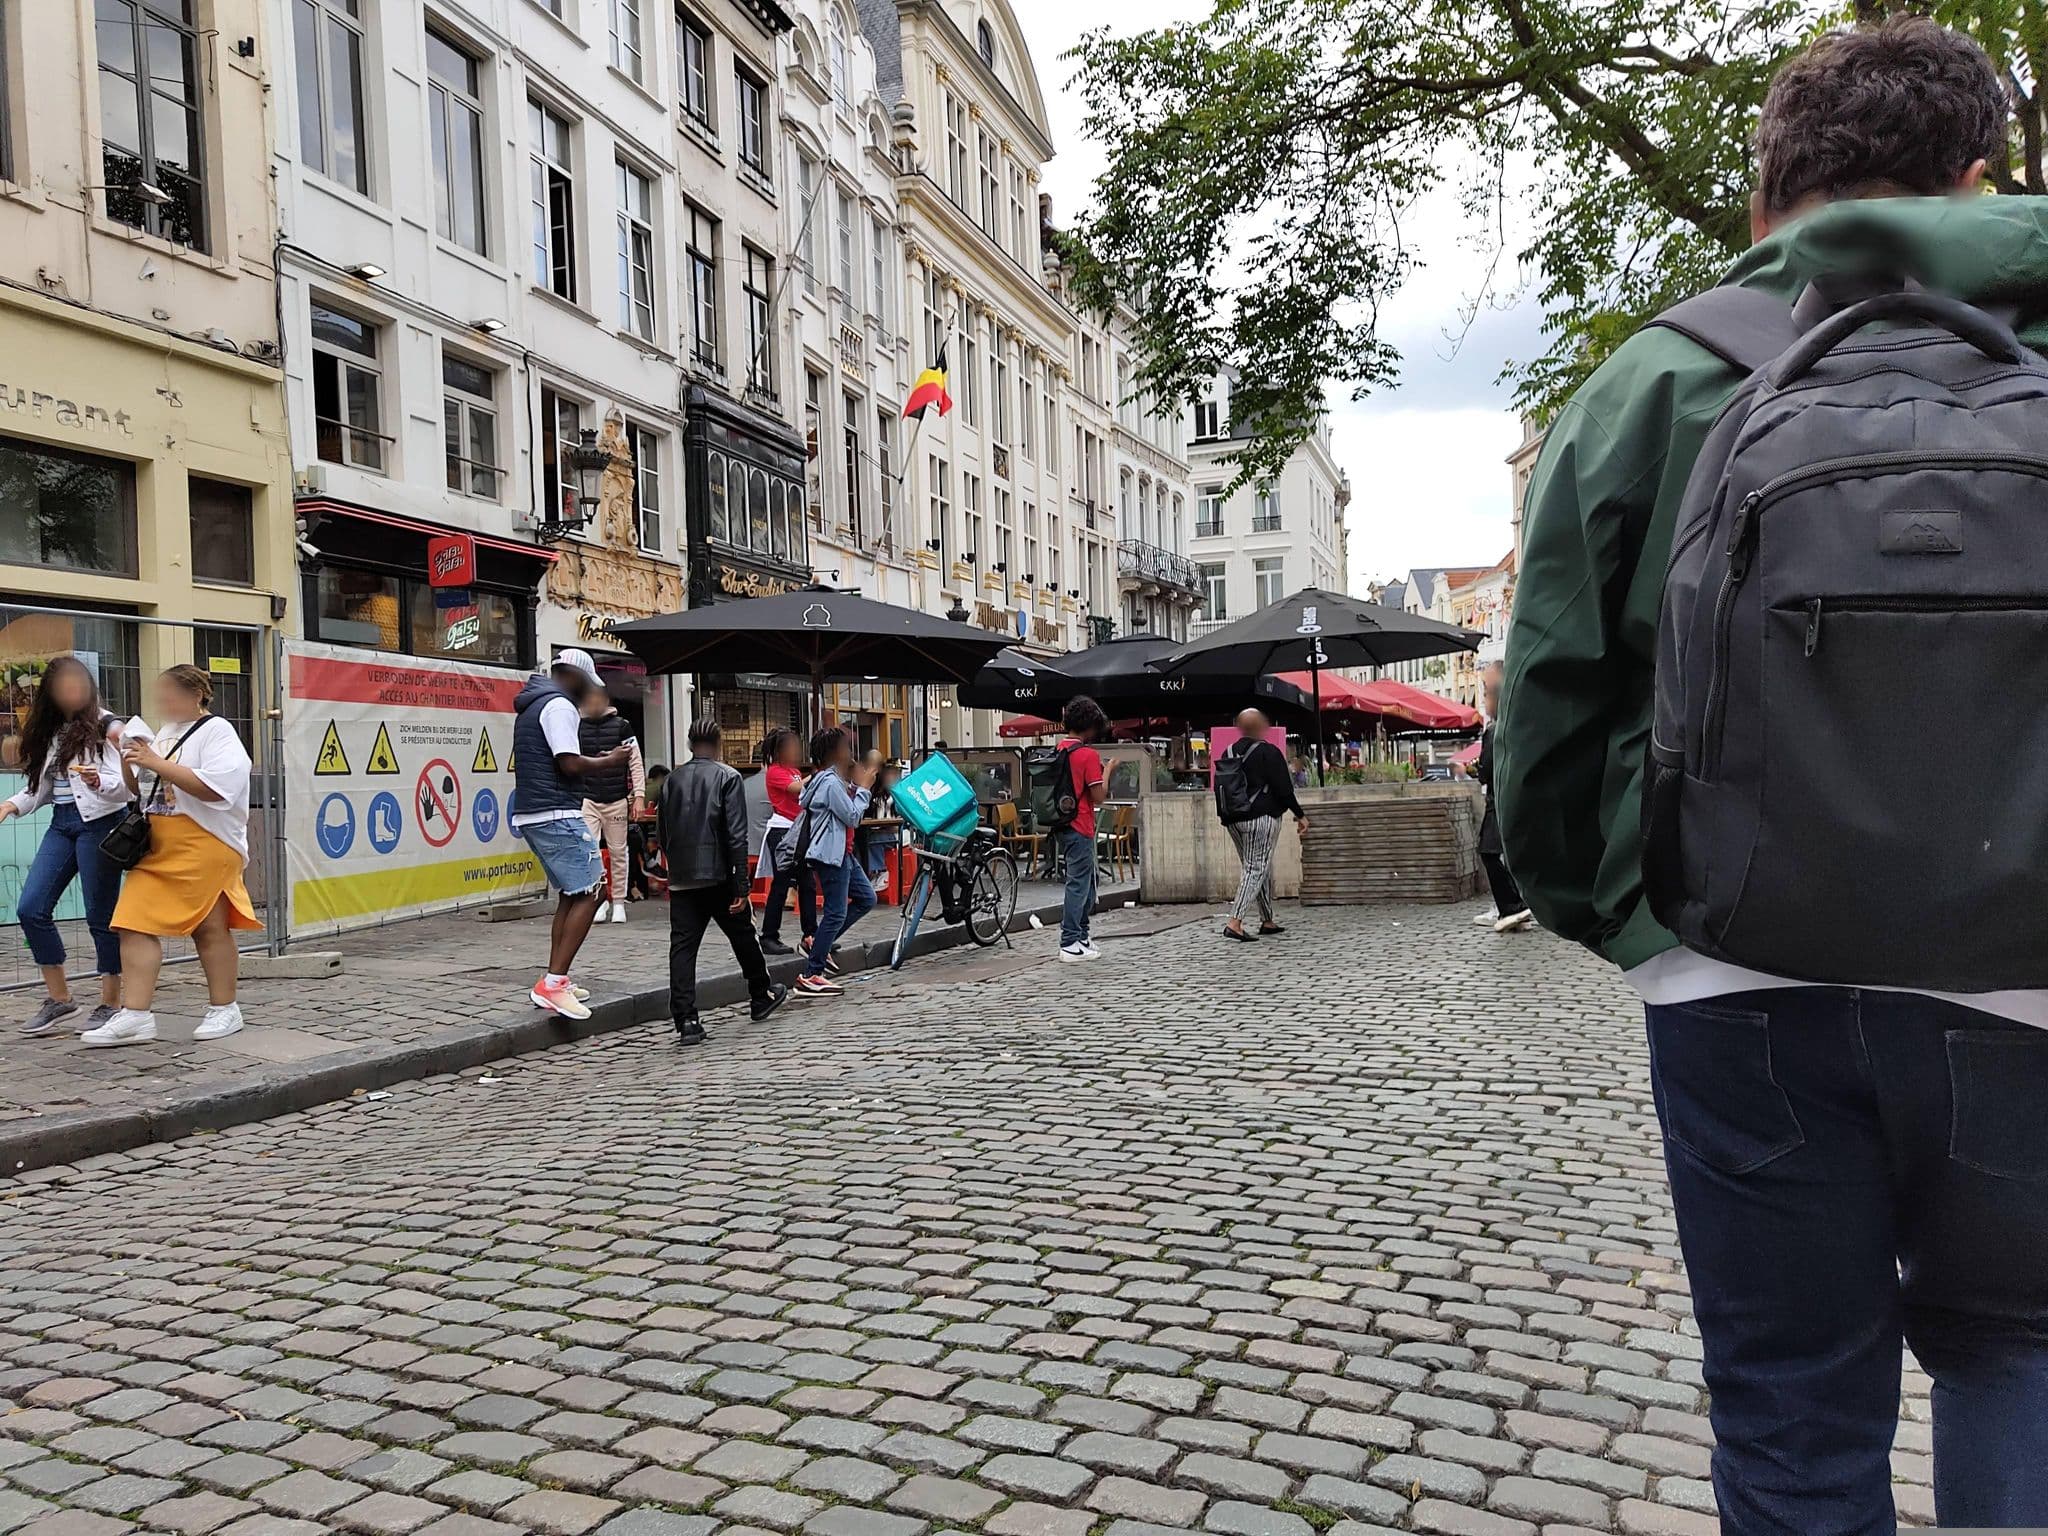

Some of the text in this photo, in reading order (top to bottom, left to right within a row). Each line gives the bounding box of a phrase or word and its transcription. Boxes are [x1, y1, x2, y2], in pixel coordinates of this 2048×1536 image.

[367, 670, 415, 686] VERBODEN
[404, 691, 418, 704] AU
[420, 692, 455, 706] CHANTIER
[464, 861, 533, 882] www.portus.pro
